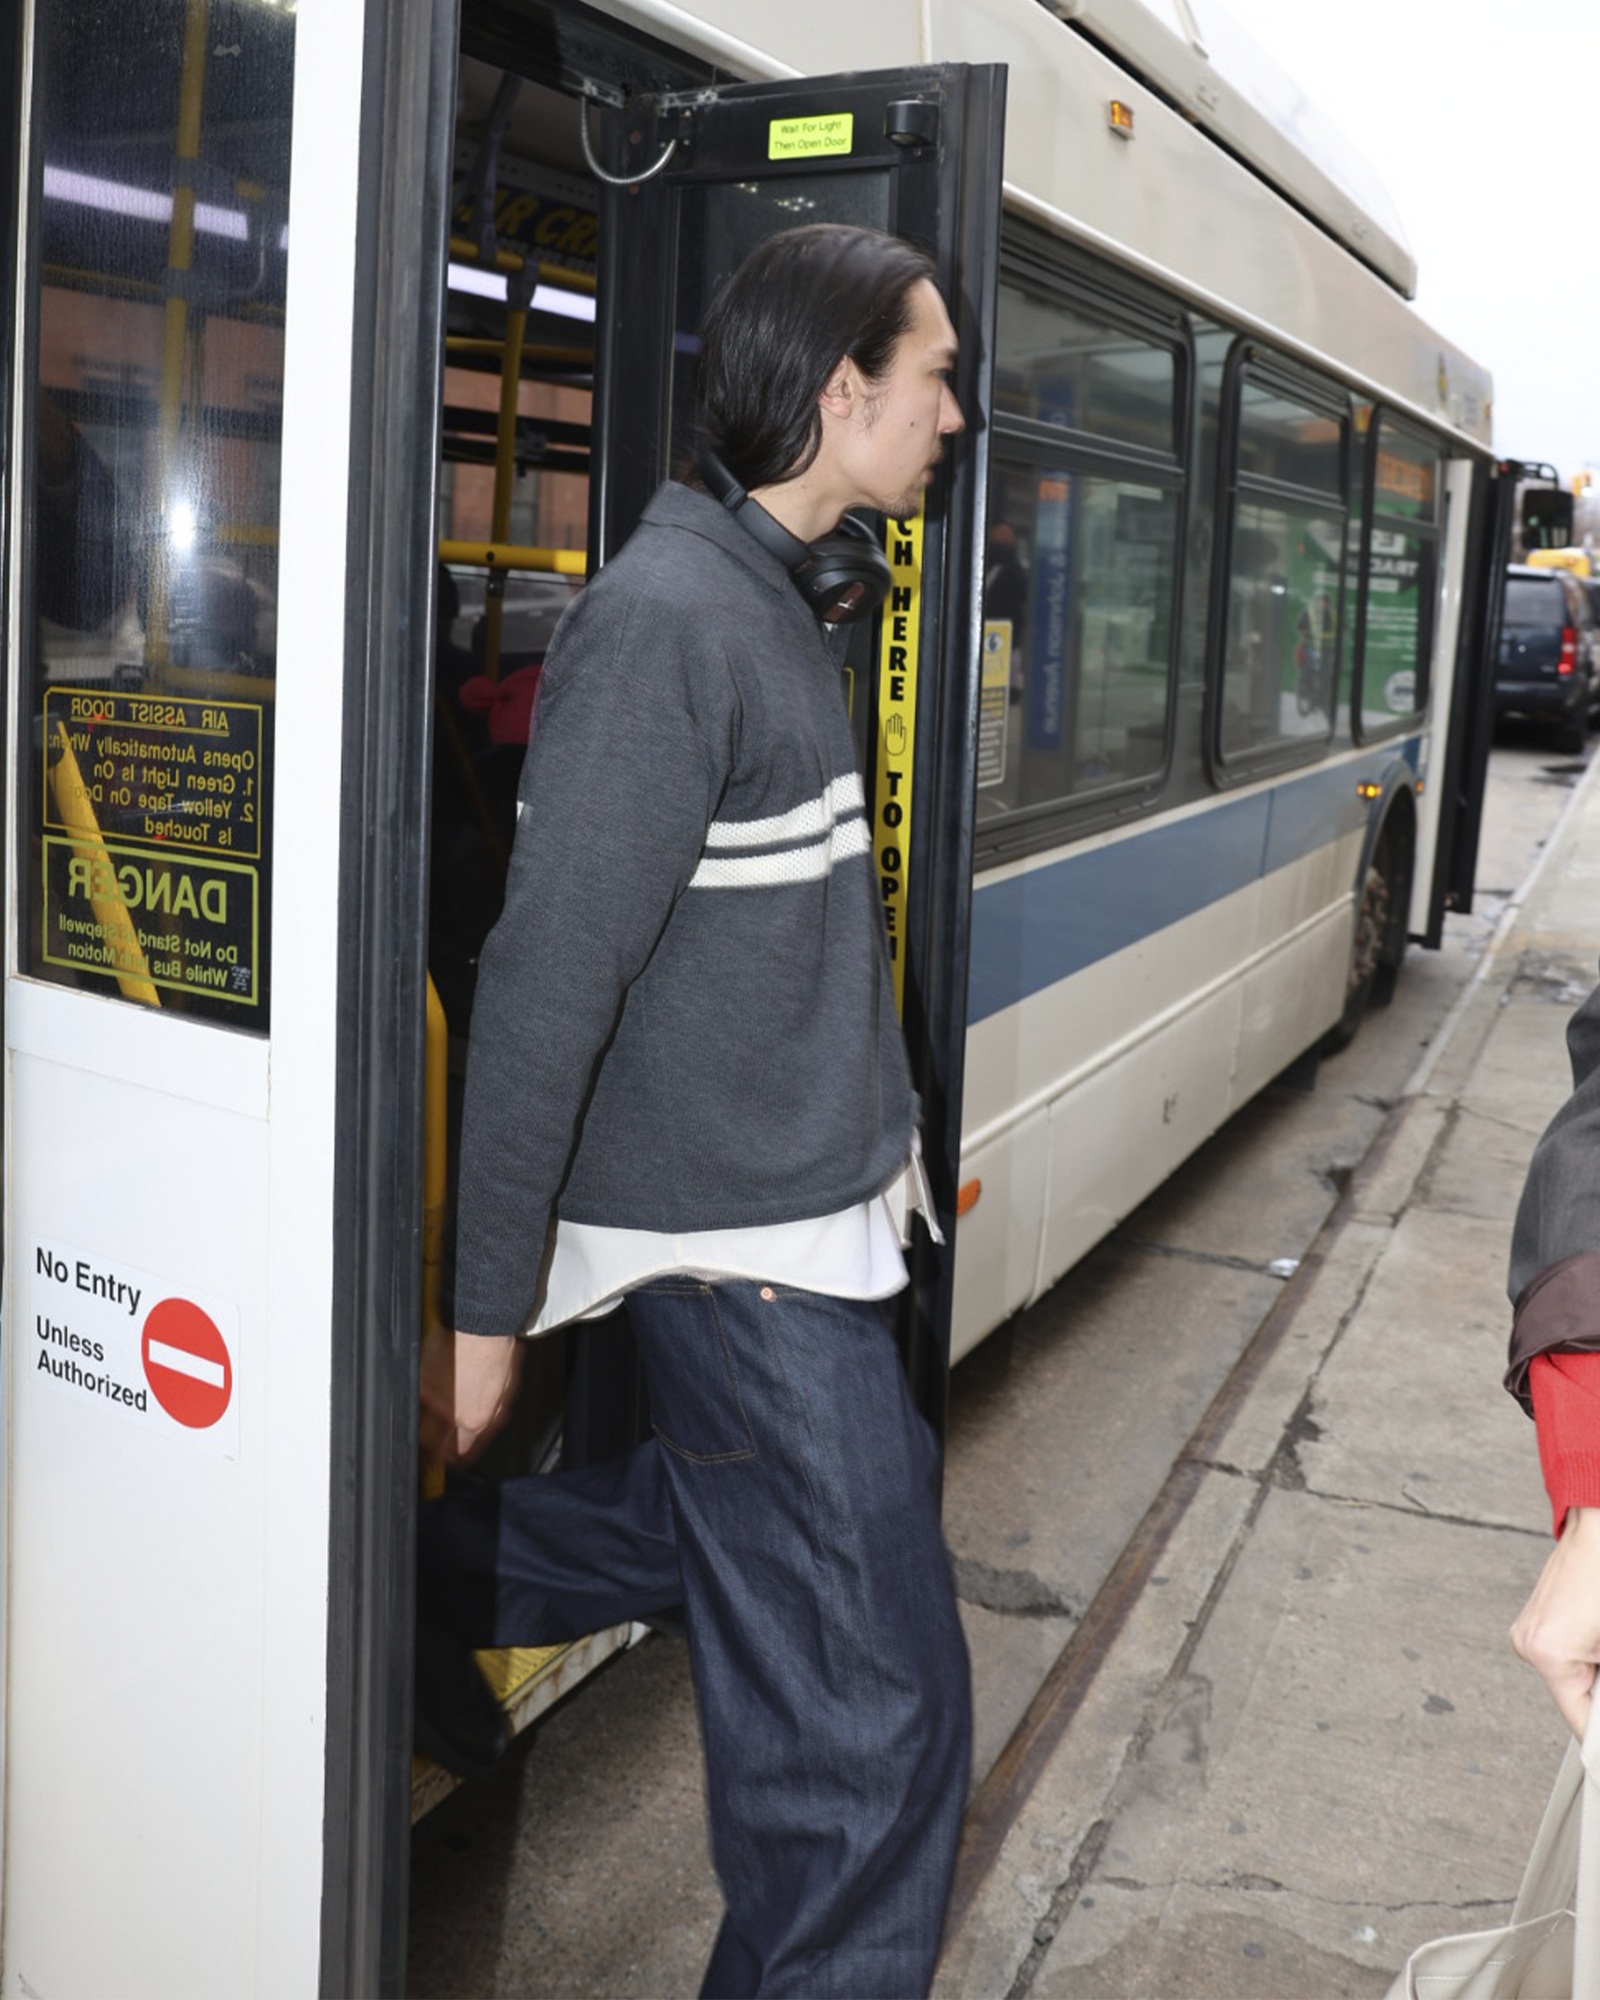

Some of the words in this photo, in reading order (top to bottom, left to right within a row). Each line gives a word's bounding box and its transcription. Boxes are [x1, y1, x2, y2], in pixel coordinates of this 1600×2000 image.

[774, 141, 795, 150] Then
[799, 138, 822, 151] Open
[825, 137, 846, 147] Door
[781, 124, 800, 134] Wait
[802, 121, 817, 133] For
[819, 120, 842, 134] Light
[889, 586, 911, 702] HERE
[882, 771, 903, 829] TO
[36, 1246, 69, 1284] No
[75, 1260, 142, 1316] Entry
[36, 1314, 105, 1362] Unless
[37, 1349, 148, 1413] Authorized
